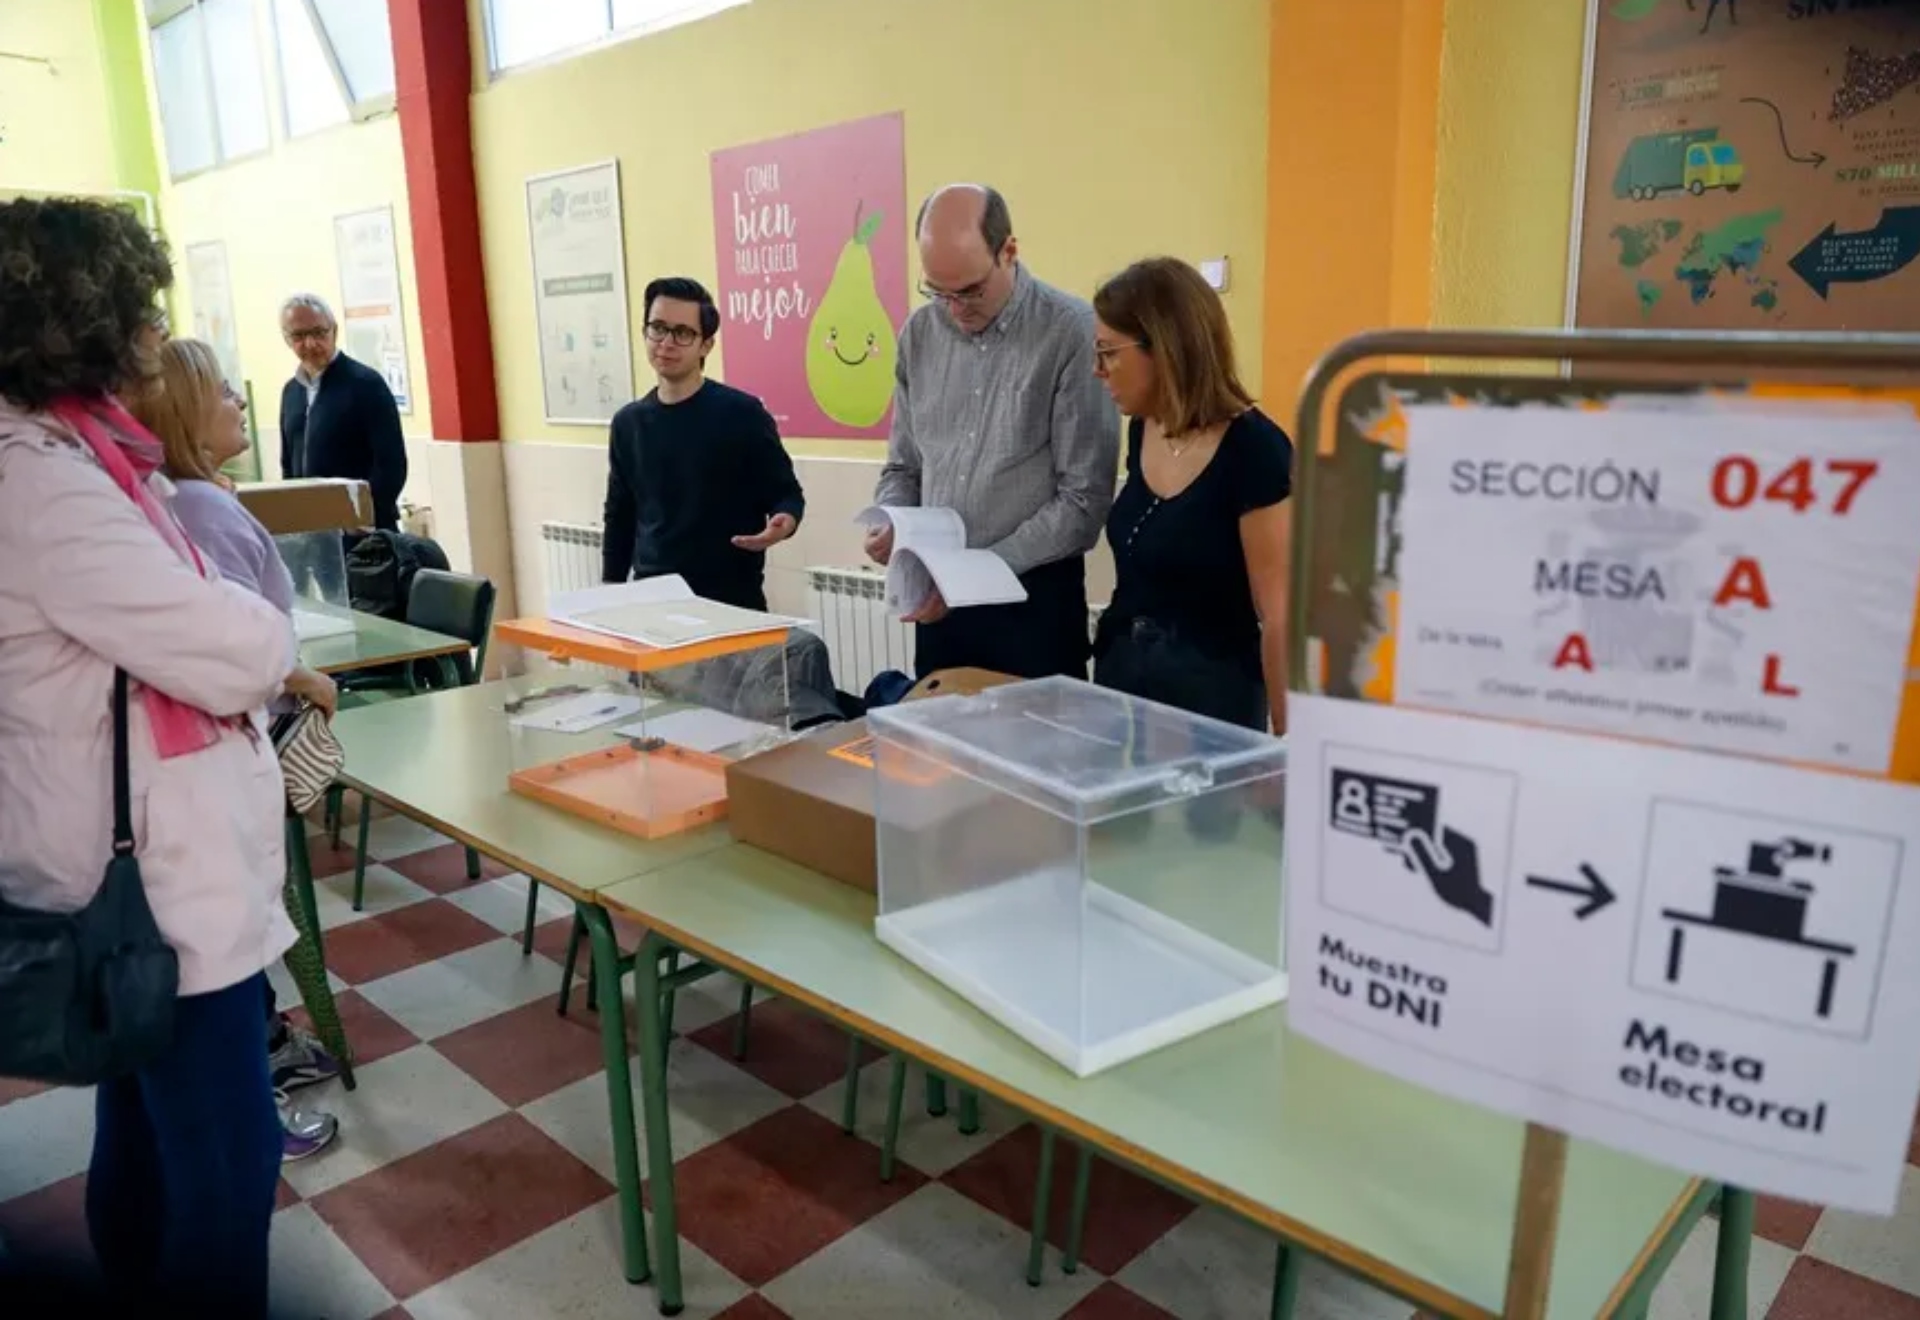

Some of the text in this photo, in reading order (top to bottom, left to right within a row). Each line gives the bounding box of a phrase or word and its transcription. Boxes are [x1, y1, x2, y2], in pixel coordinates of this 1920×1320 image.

[744, 163, 780, 196] COMER
[732, 191, 796, 244] bien
[735, 241, 798, 275] PARA CRECER
[728, 277, 811, 340] mejor
[1450, 453, 1880, 517] SECCIÓN 047
[1534, 555, 1772, 610] MESA A
[1552, 632, 1594, 672] A
[1762, 652, 1799, 698] L
[1319, 932, 1448, 995] Muestra
[1318, 964, 1441, 1028] tu DNI
[1623, 1018, 1764, 1083] Mesa
[1618, 1060, 1827, 1134] electoral
